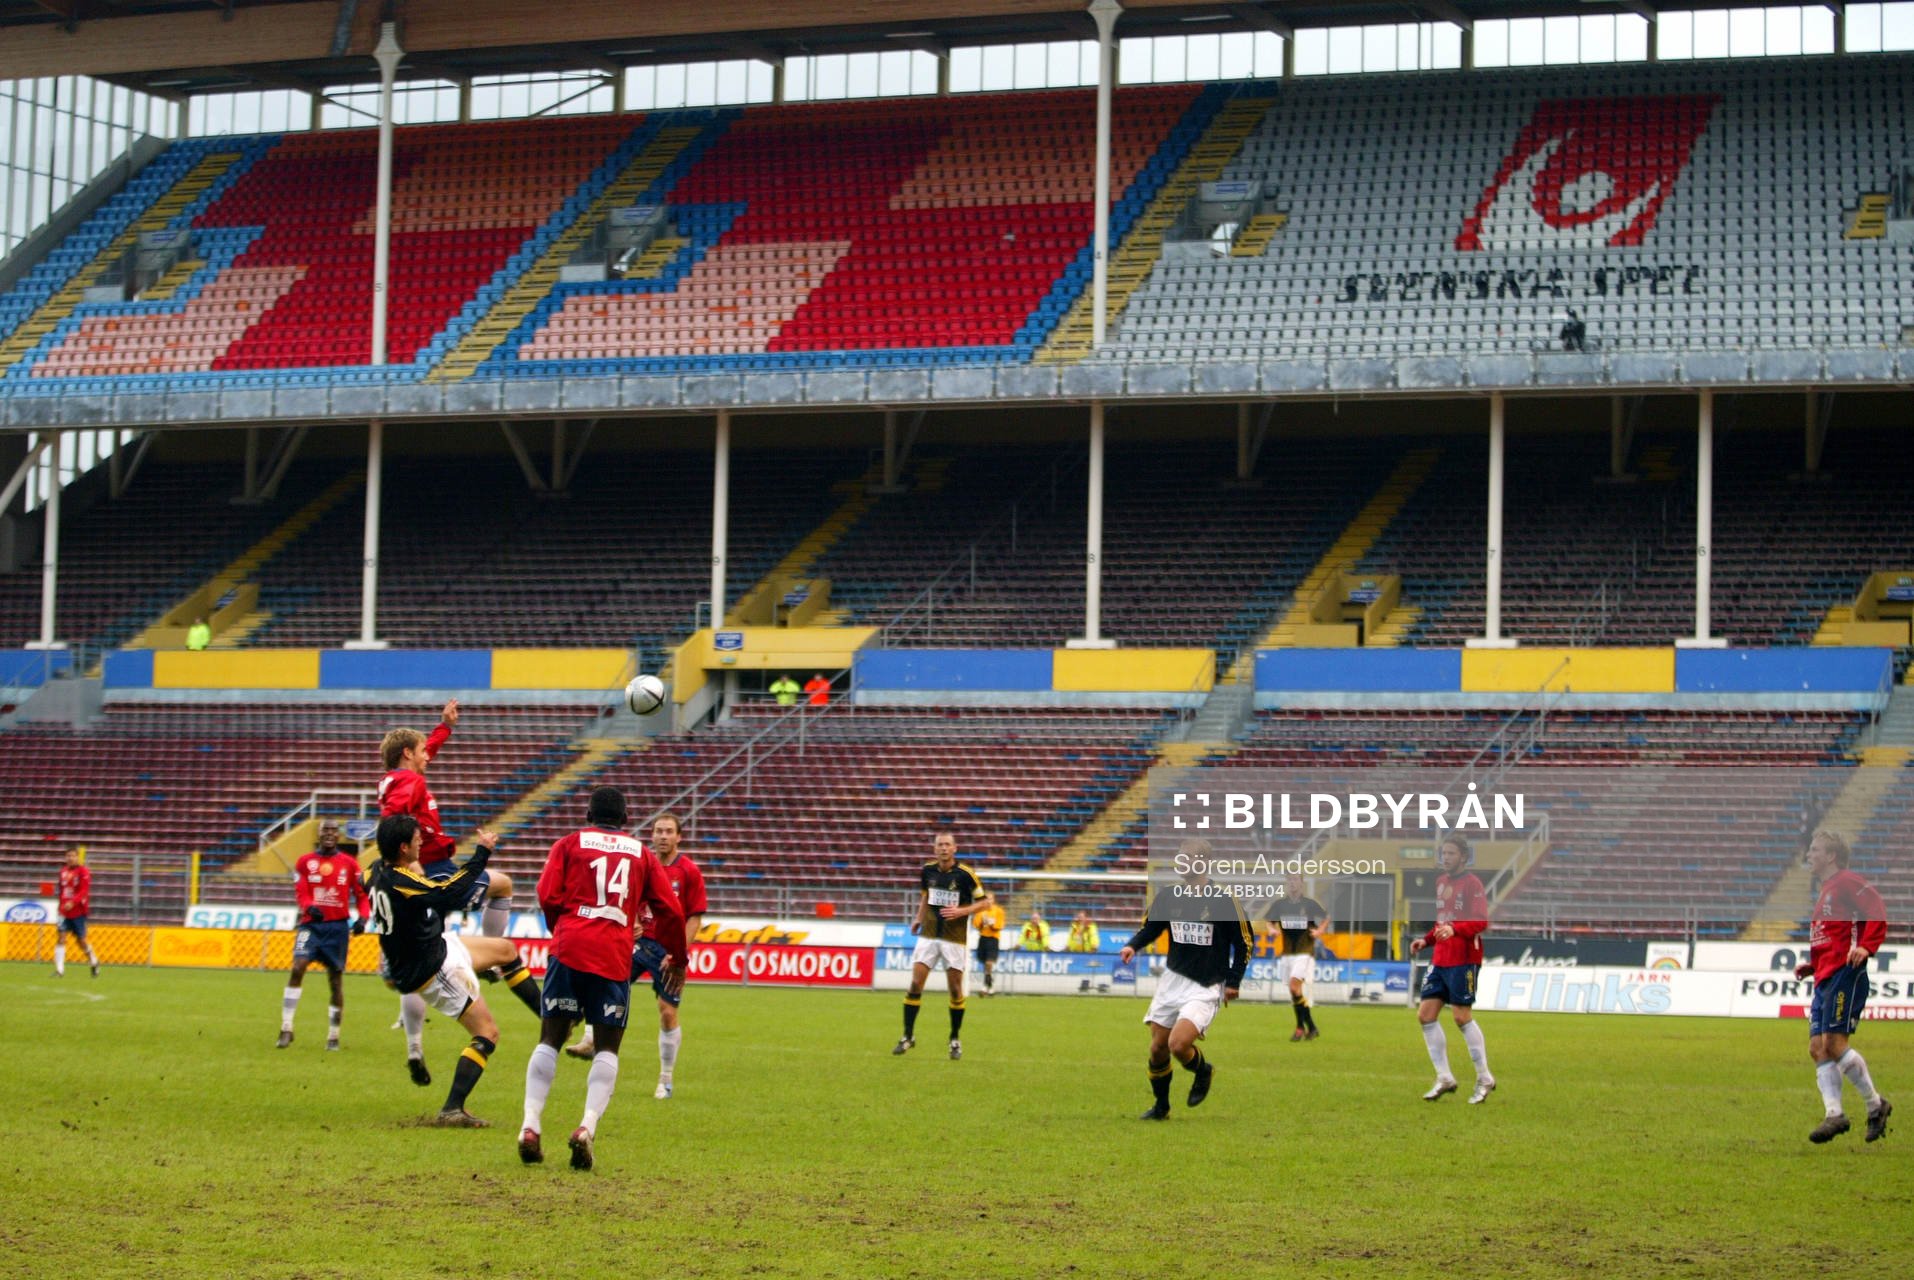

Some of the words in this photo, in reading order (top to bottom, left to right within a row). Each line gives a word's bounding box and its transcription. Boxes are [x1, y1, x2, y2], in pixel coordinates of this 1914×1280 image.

[589, 856, 631, 909] 14
[191, 909, 278, 930] sana
[729, 950, 862, 979] COSMOPOL
[1040, 953, 1072, 974] bor
[1494, 971, 1672, 1014] Flinks
